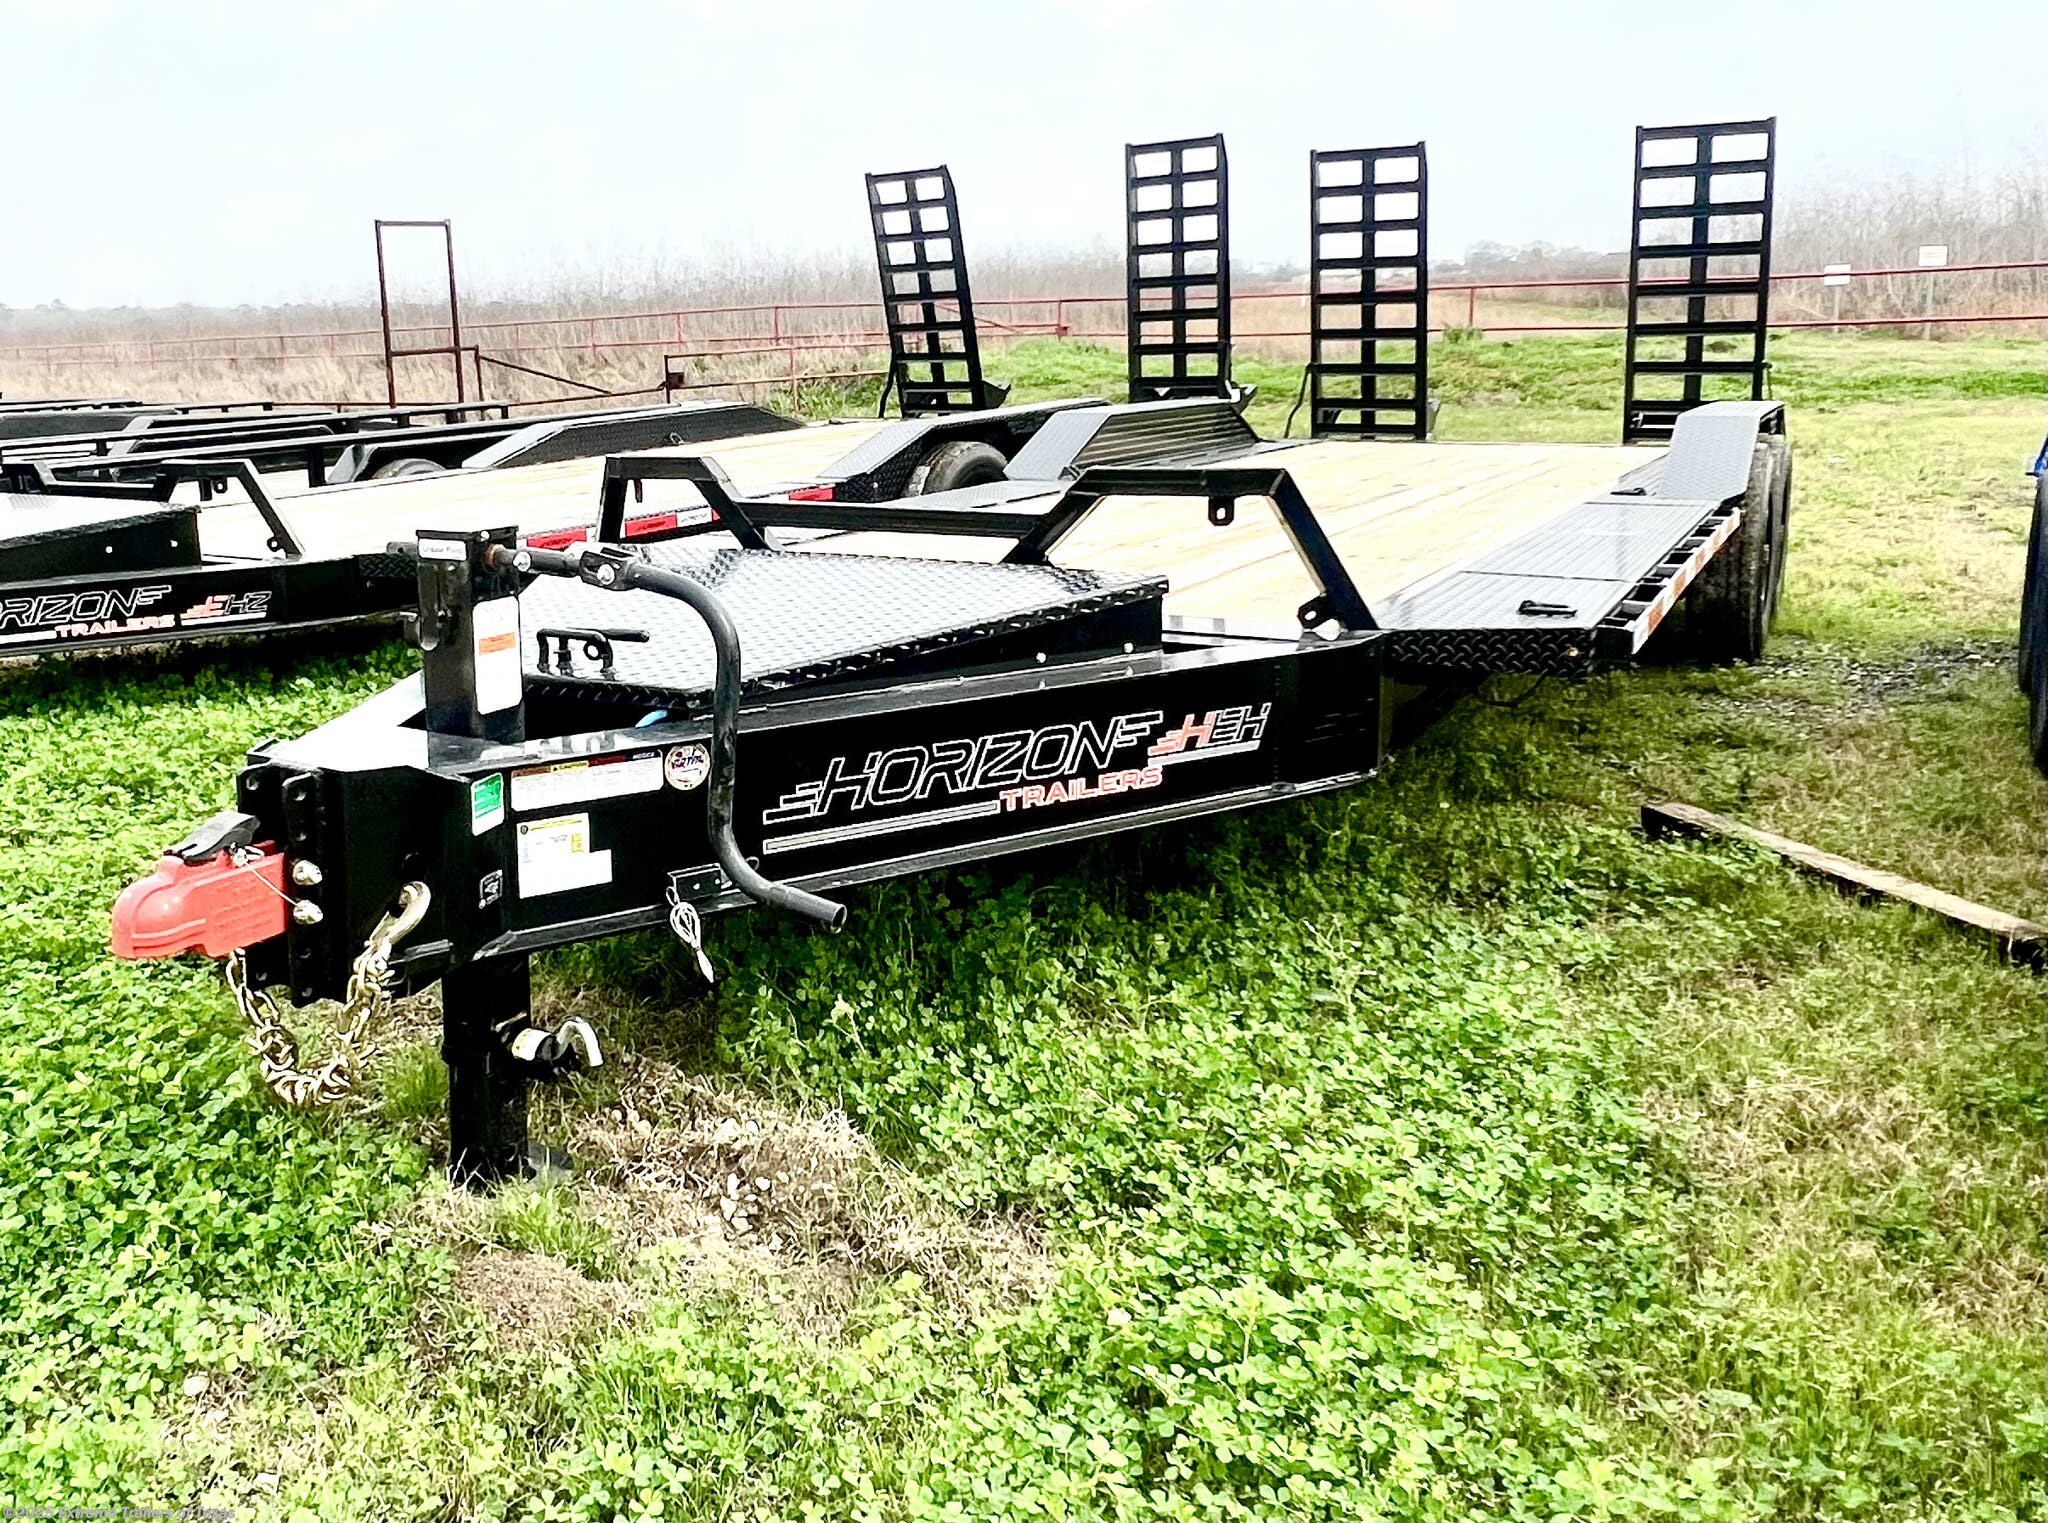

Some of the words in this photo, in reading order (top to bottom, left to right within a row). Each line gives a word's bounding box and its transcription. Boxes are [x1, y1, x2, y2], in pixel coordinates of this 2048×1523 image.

[0, 586, 160, 629] RIZON
[54, 614, 175, 638] TRAILERS
[780, 712, 1150, 821] HORIZON
[999, 765, 1163, 812] TRAILERS
